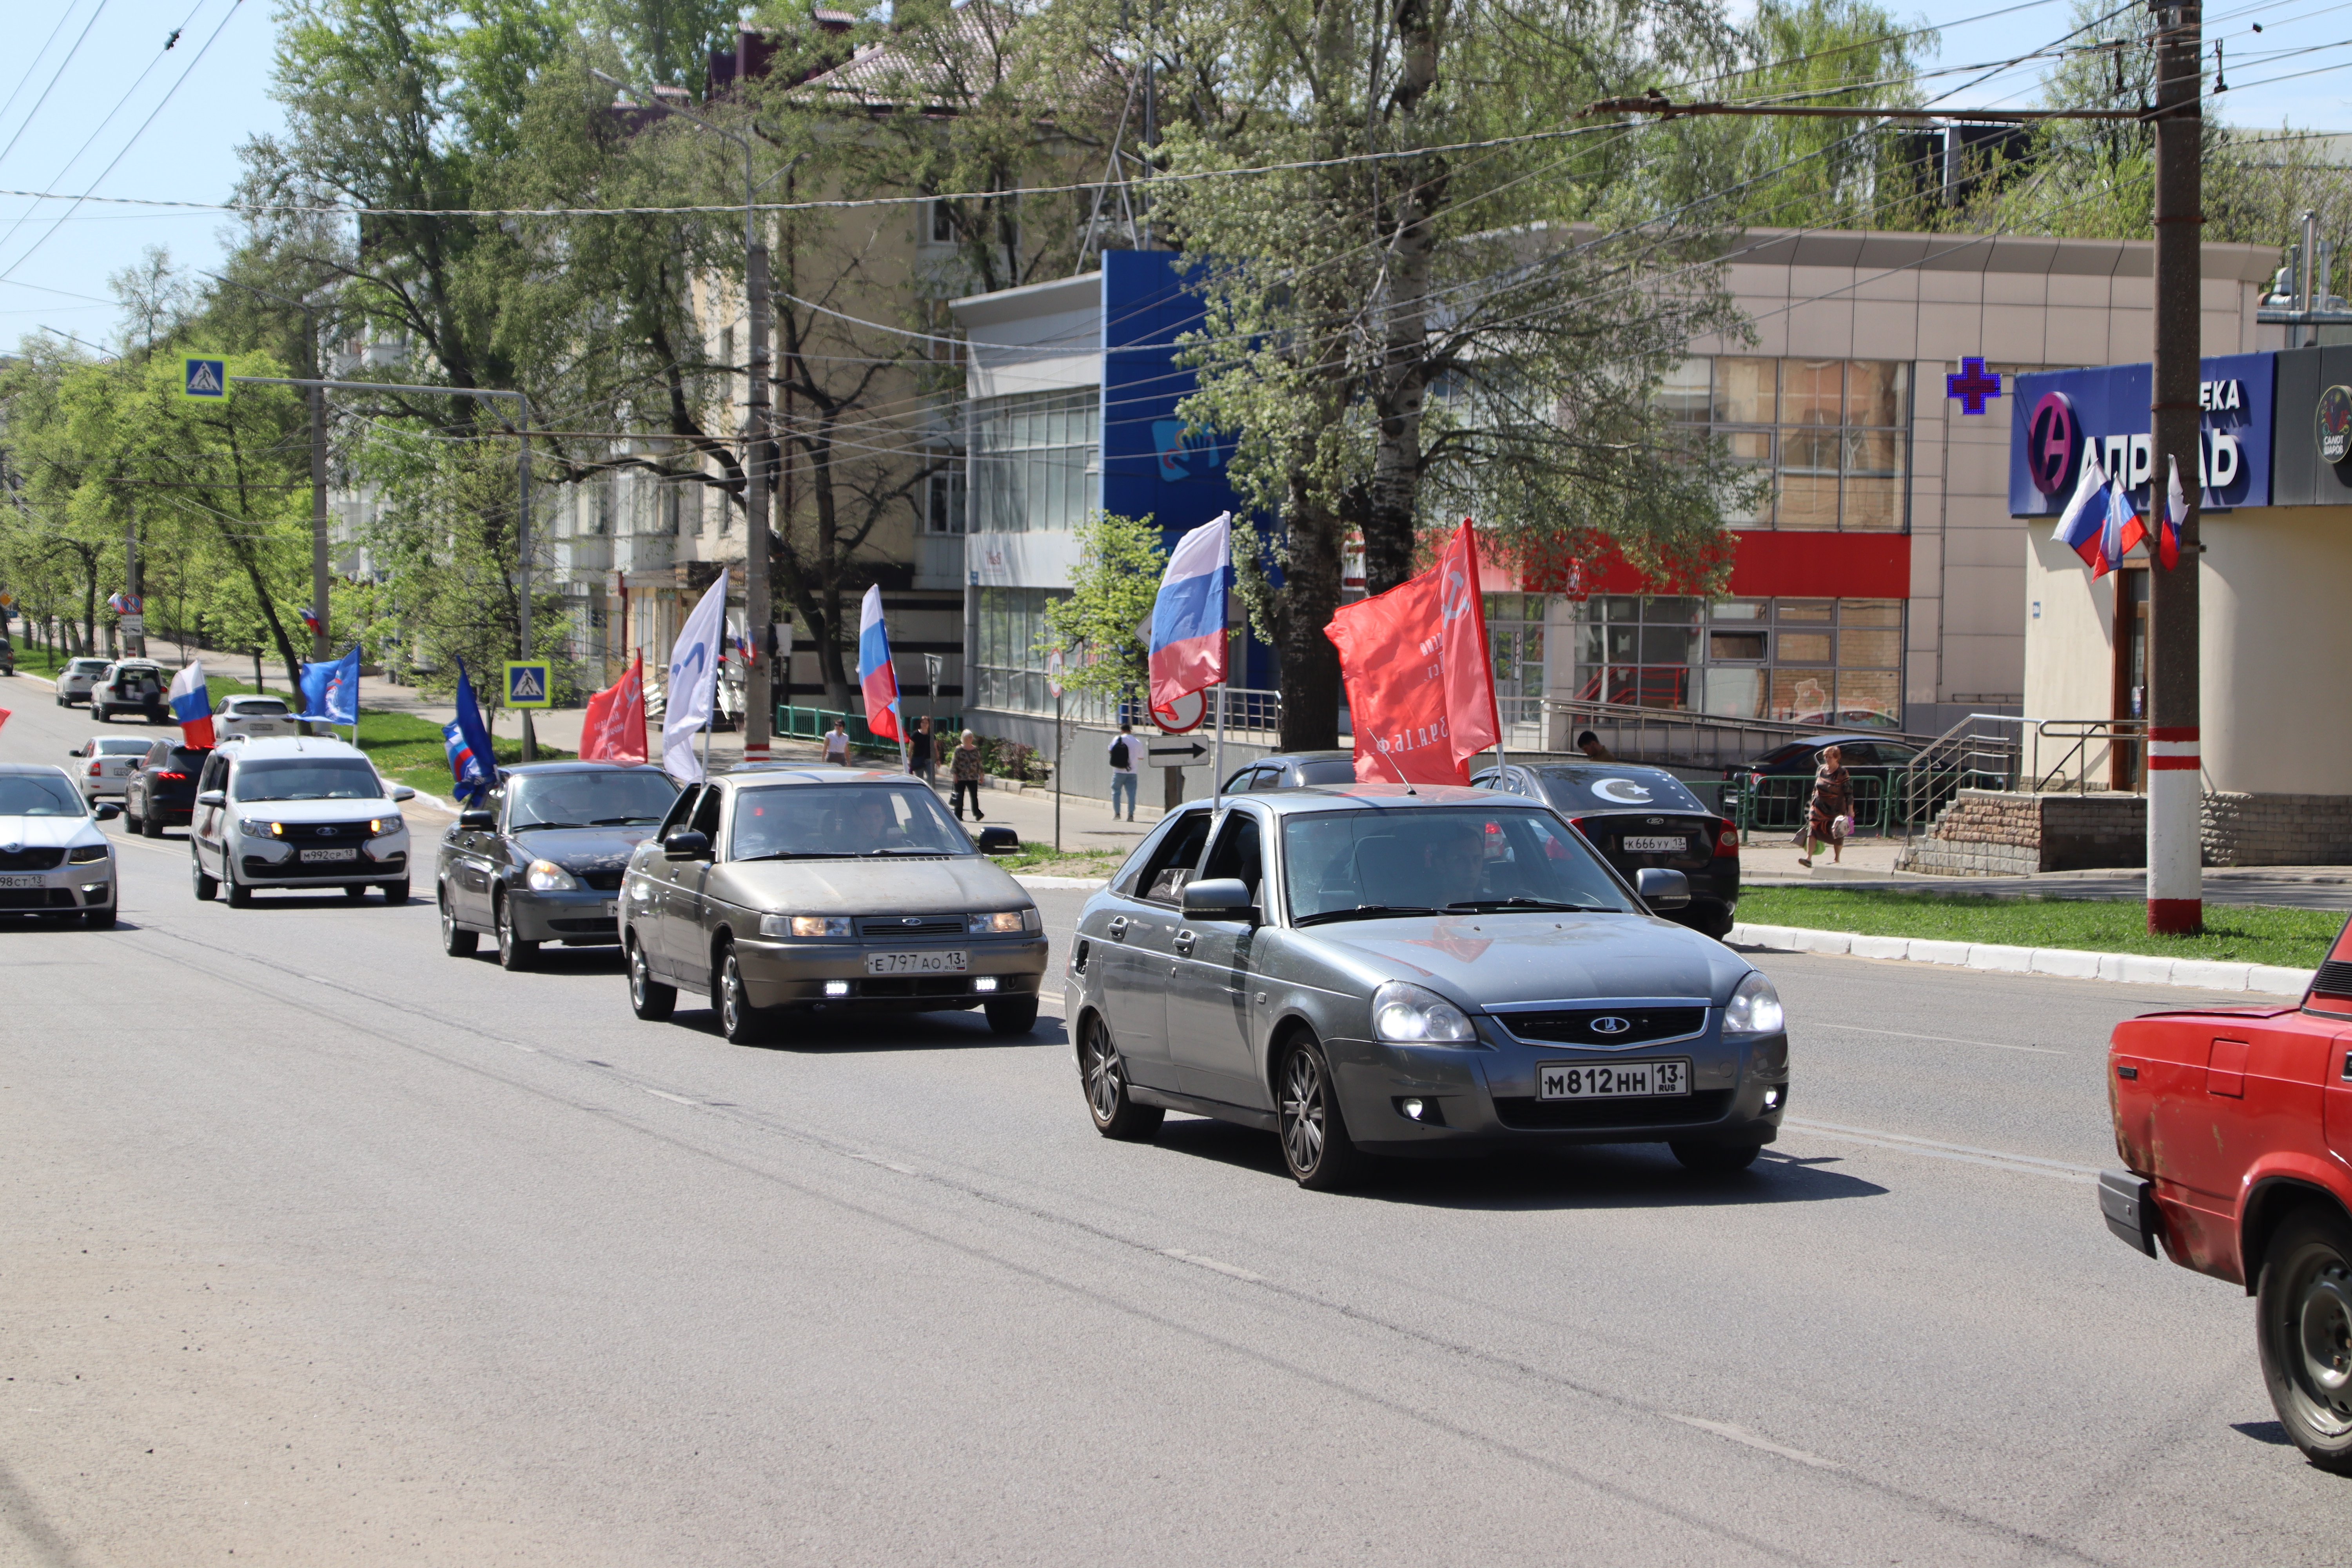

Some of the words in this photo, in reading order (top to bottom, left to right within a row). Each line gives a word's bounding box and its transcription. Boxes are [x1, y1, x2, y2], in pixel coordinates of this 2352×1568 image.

[2200, 379, 2240, 411] ЕКА
[2324, 435, 2344, 445] САЛЮТ
[2324, 445, 2343, 455] ШАРОВ
[947, 953, 960, 964] 13
[1548, 1069, 1646, 1095] М812НН
[1657, 1065, 1678, 1084] 13
[1659, 1084, 1676, 1092] RUS
